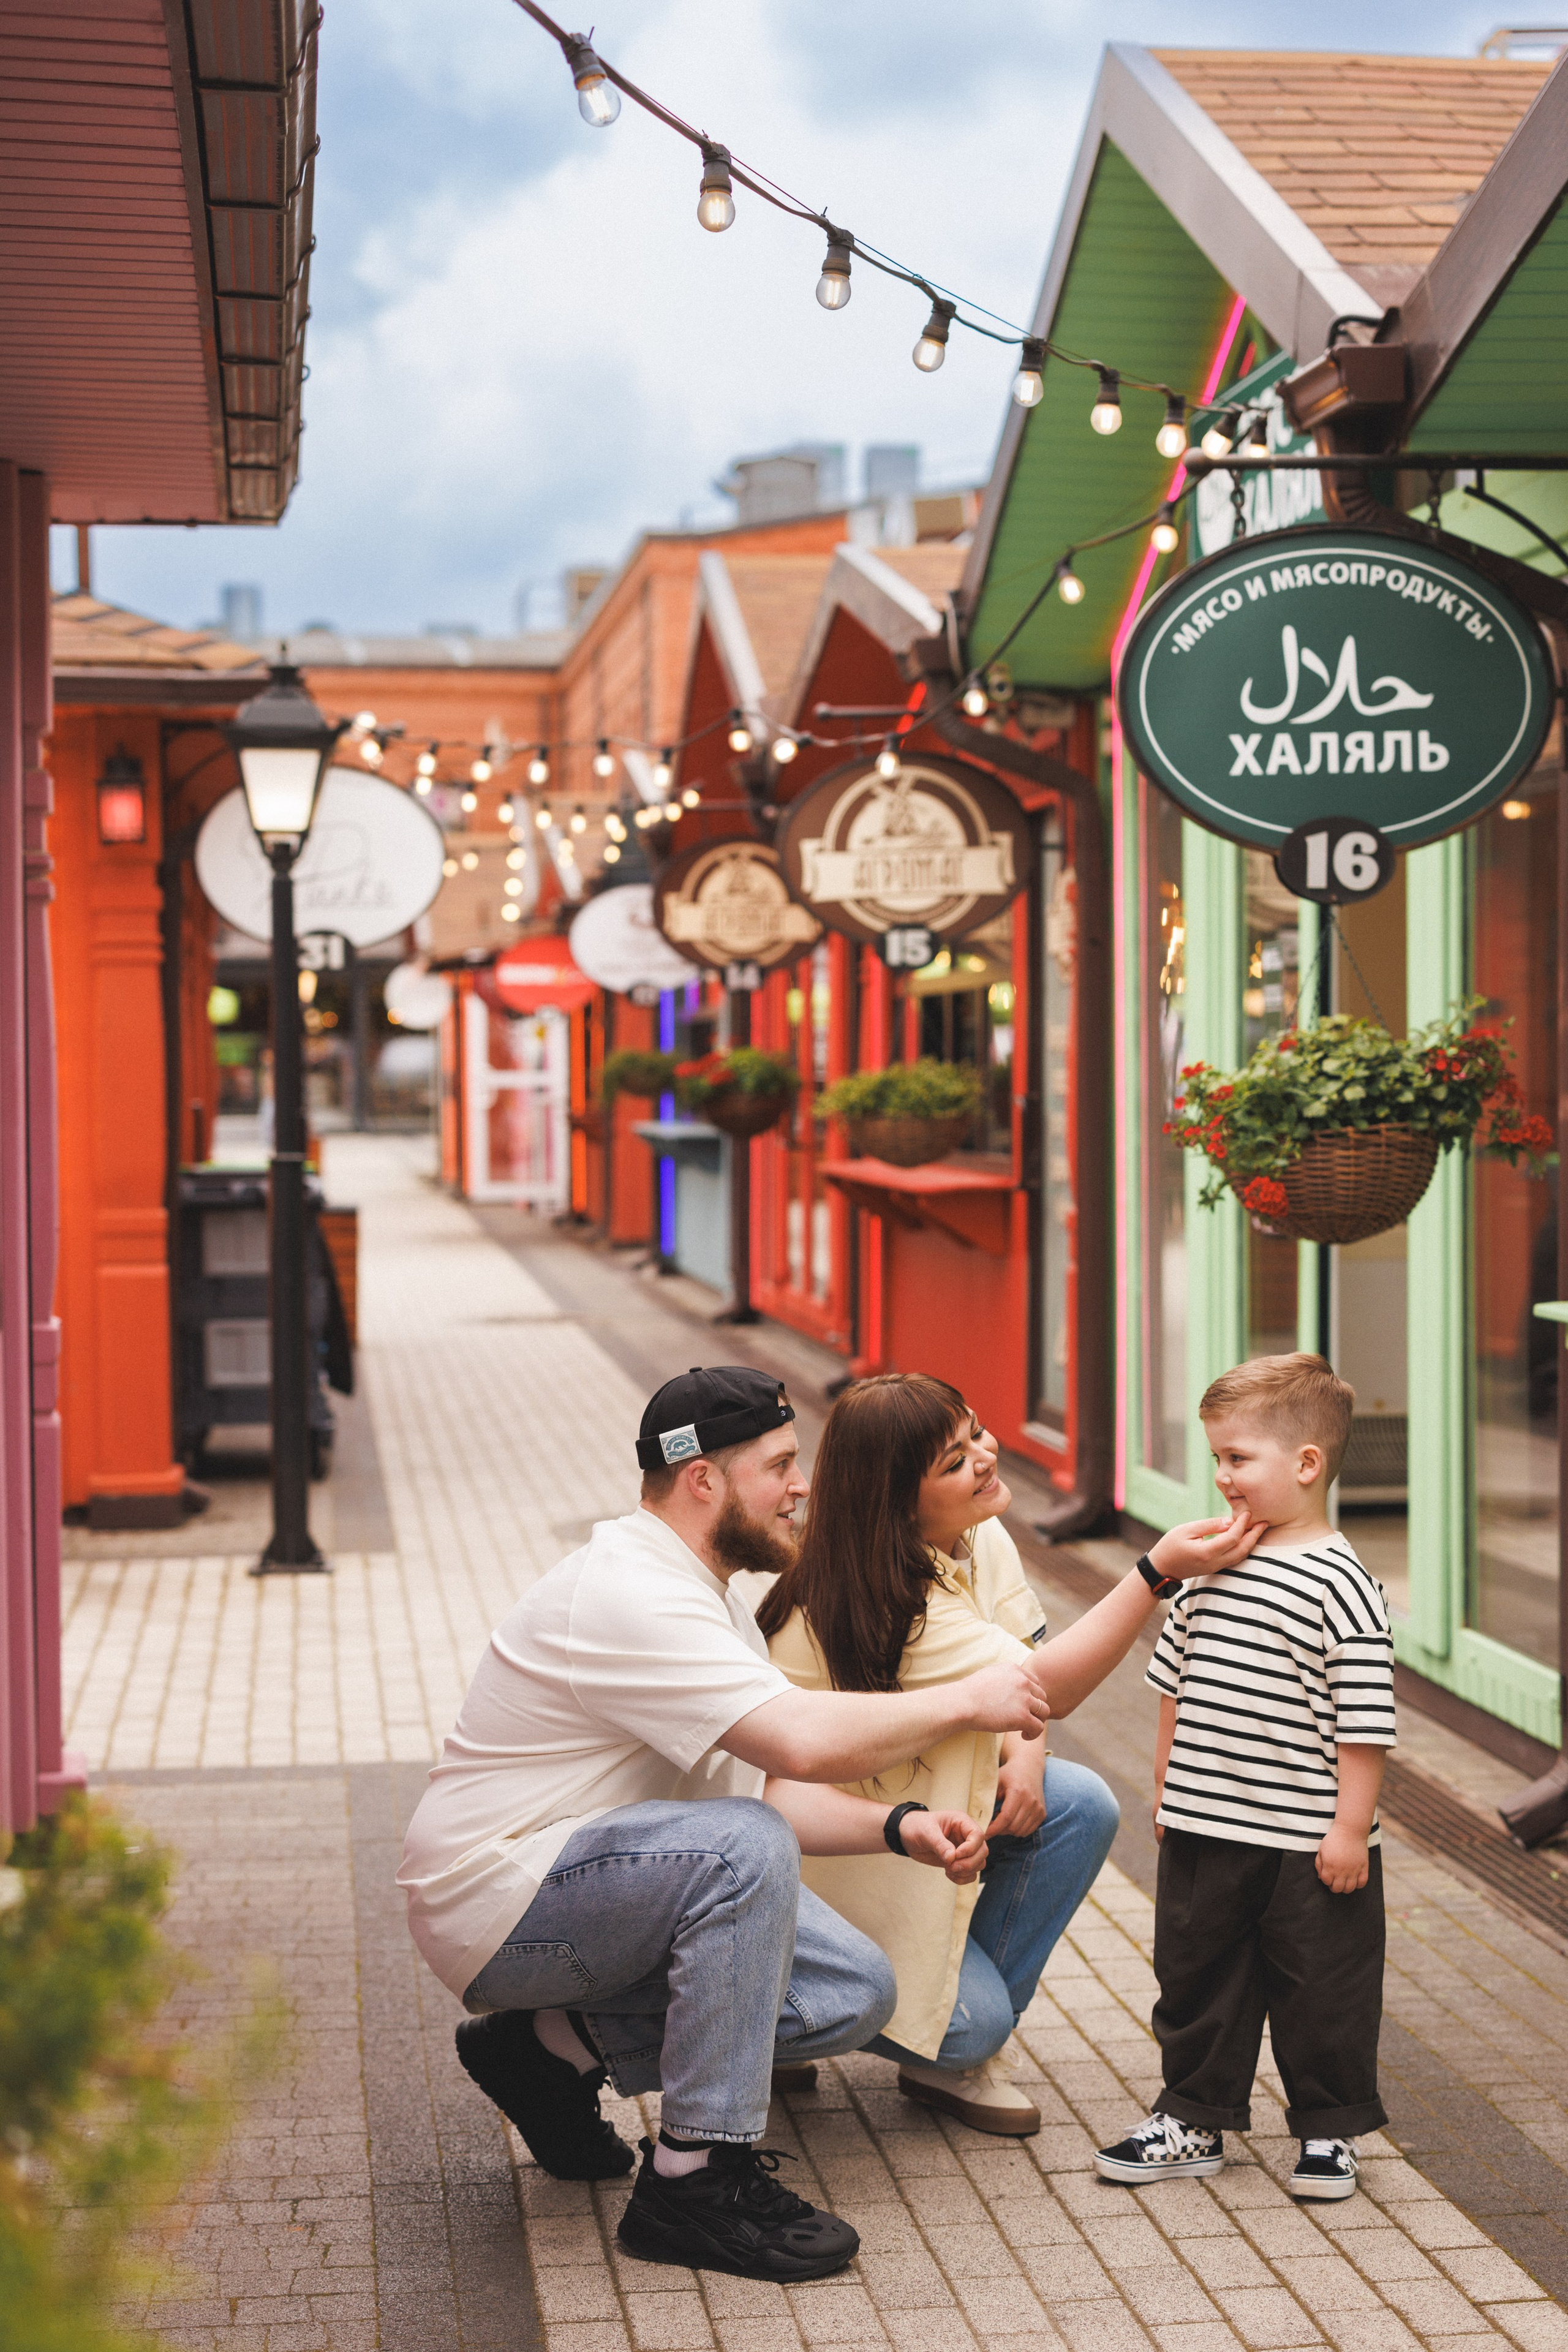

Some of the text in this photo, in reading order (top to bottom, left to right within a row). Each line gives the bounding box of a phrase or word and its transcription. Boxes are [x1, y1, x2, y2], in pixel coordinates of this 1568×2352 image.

[1173, 562, 1490, 652] МЯСО И МЯСОПРОДУКТЫ
[1240, 624, 1434, 725] حلال
[1229, 729, 1450, 777] ХАЛЯЛЬ
[1305, 831, 1379, 891] 16
[296, 935, 344, 970] 31
[886, 927, 930, 967] 15
